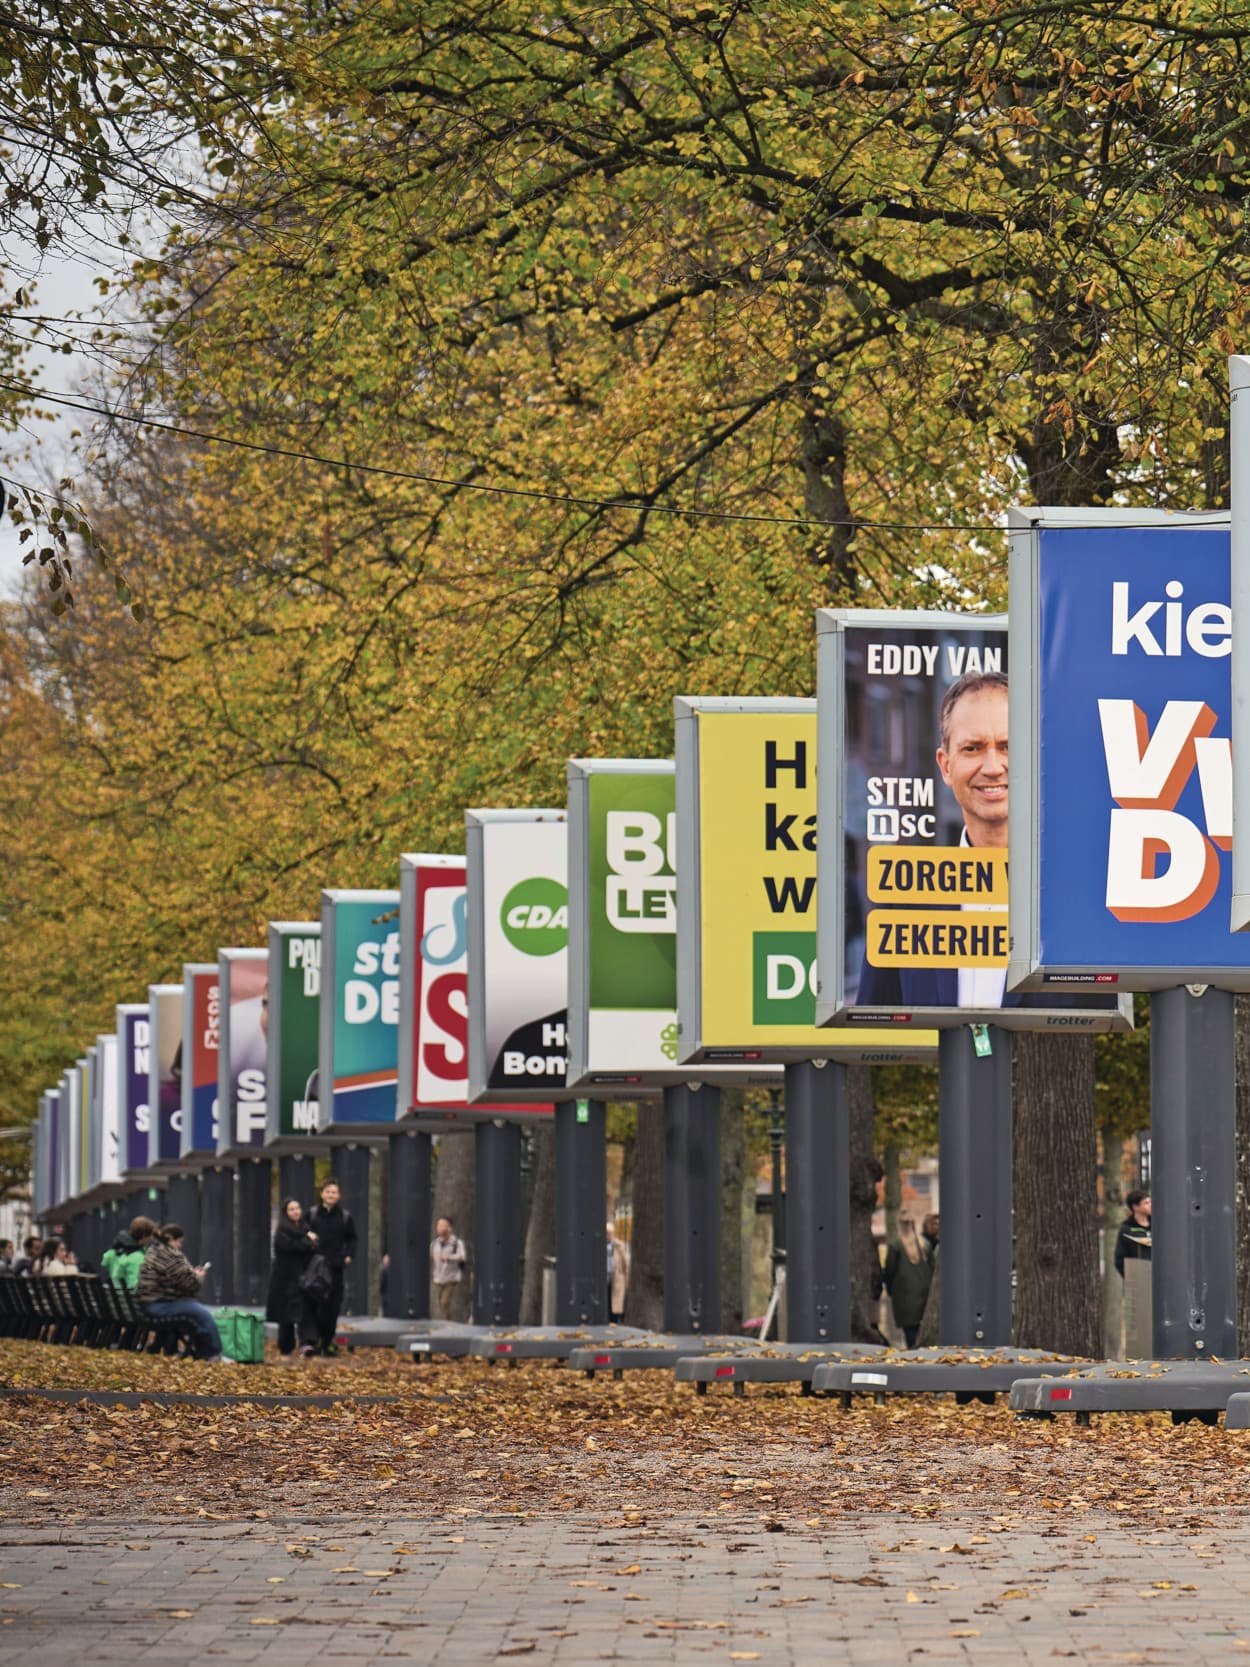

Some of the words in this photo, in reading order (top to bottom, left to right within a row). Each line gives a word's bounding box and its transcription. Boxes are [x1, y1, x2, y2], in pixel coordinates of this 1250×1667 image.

[1112, 580, 1232, 657] kie
[867, 643, 939, 677] EDDY
[946, 645, 1002, 678] VAN
[765, 741, 817, 788] H
[867, 777, 934, 807] STEM
[879, 859, 993, 893] ZORGEN
[878, 923, 1007, 957] ZEKERHE
[542, 1024, 568, 1047] H
[504, 1052, 568, 1075] Bon
